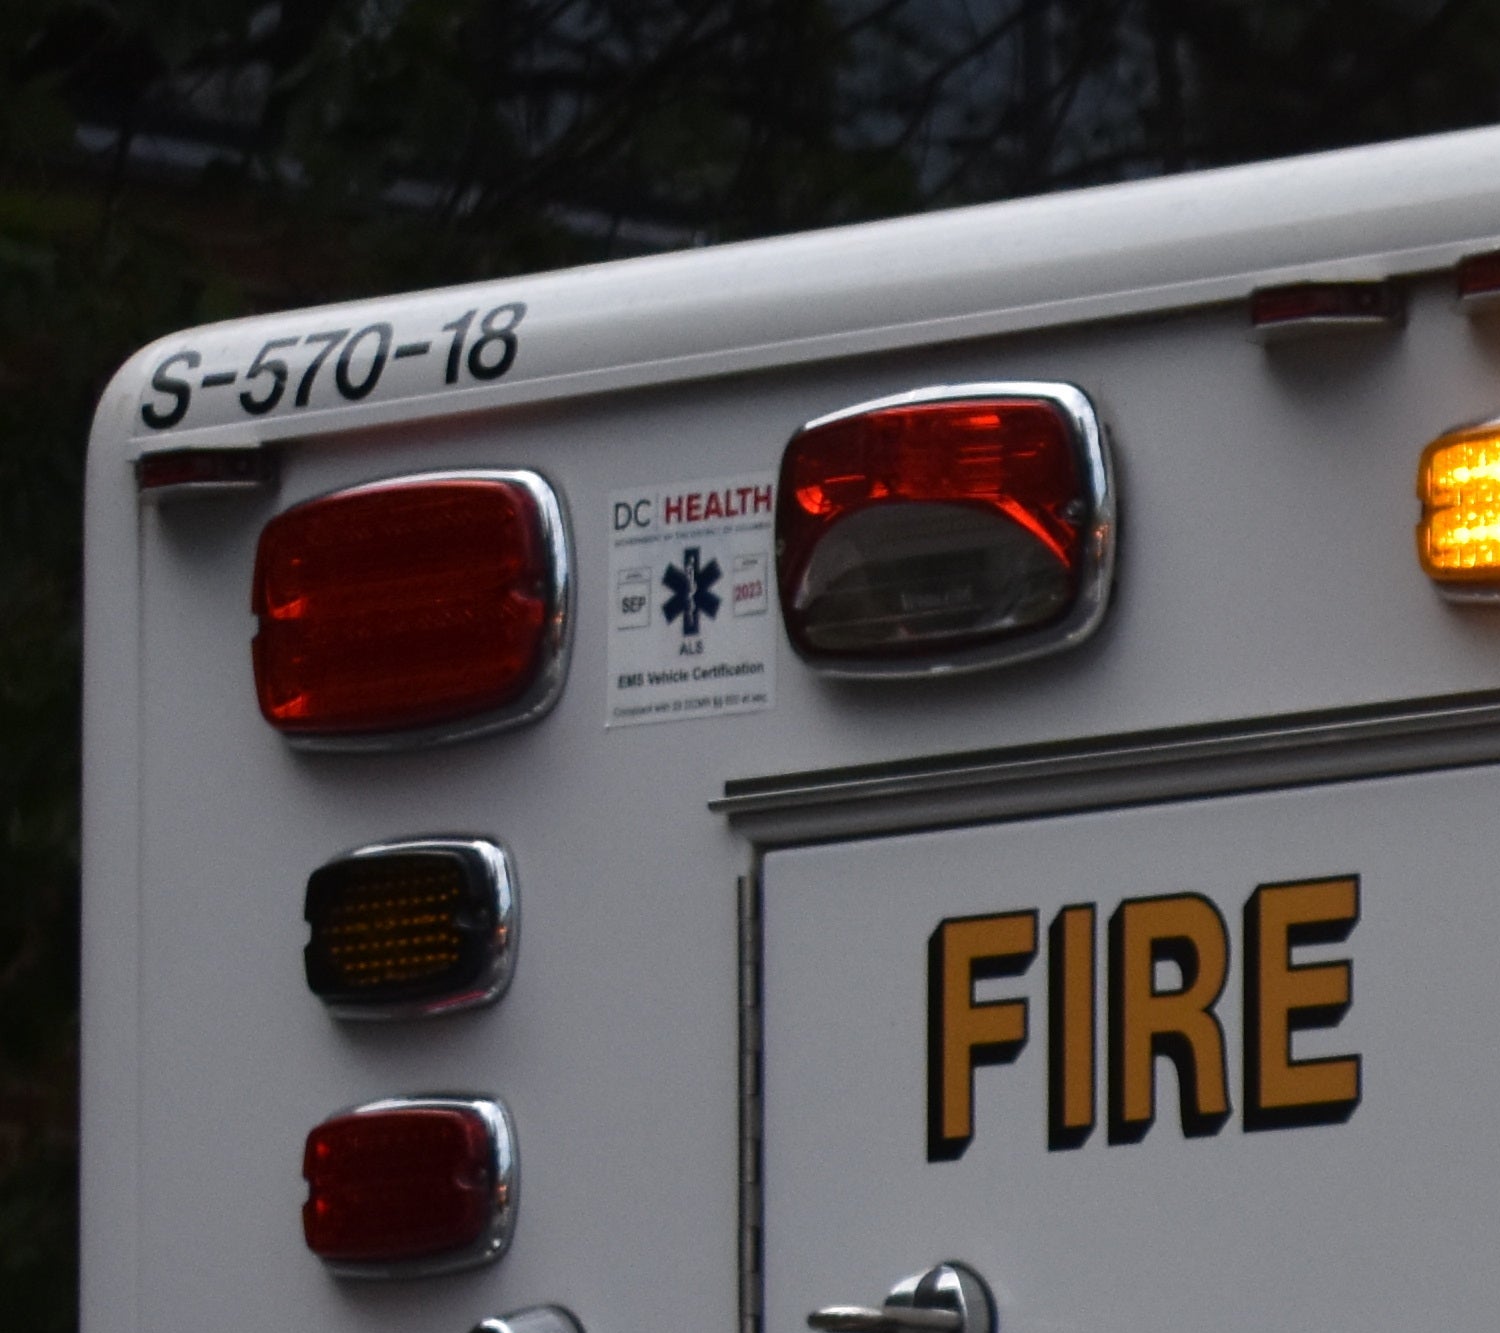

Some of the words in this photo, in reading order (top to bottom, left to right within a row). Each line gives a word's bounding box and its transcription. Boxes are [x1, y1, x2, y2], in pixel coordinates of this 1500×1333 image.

[141, 301, 528, 430] S-570-18
[614, 499, 652, 531] DC
[664, 484, 774, 525] HEALTH
[622, 596, 646, 614] SEP
[617, 672, 644, 690] EMS
[647, 669, 689, 686] Vehicle
[693, 662, 765, 681] Certification
[927, 873, 1362, 1163] FIRE
